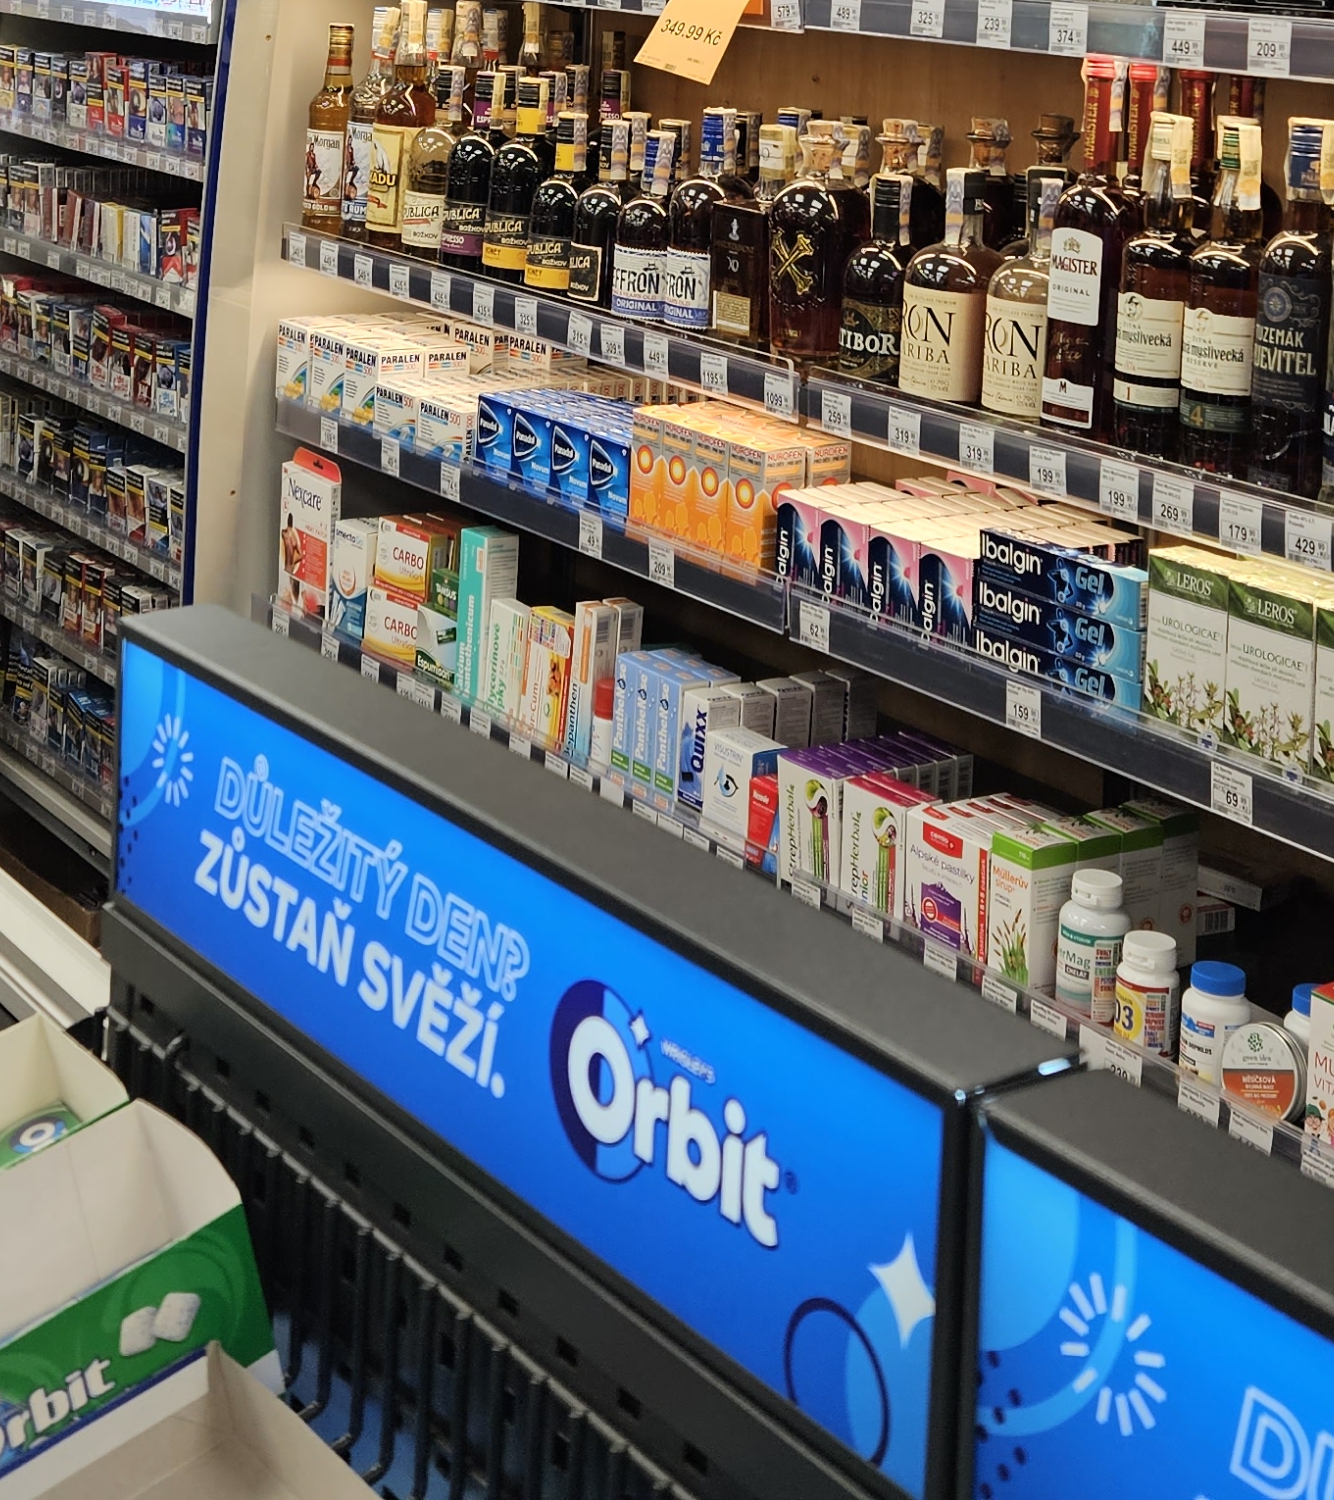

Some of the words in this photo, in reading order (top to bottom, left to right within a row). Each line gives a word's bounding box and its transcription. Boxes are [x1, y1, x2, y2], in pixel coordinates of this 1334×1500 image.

[777, 5, 792, 18] 579
[918, 11, 933, 25] 325
[660, 18, 704, 42] 349.99
[1256, 43, 1276, 58] 209
[311, 135, 341, 151] Morgan
[403, 205, 440, 221] PUBLICA
[1050, 253, 1098, 277] MAGISTER
[1052, 284, 1090, 297] ORIGINAL
[454, 327, 490, 348] PARALEN
[1256, 323, 1305, 348] UZEMÁK
[381, 353, 421, 366] PARALEN
[768, 391, 789, 407] 1099
[730, 443, 762, 461] NUROFEN
[768, 450, 804, 463] NUROFEN
[287, 476, 322, 511] Nexcare
[393, 547, 424, 570] CARBO
[982, 531, 1043, 577] Ibalgin
[654, 561, 667, 576] 209
[1075, 565, 1105, 596] Gel
[1177, 572, 1214, 599] LEROS
[978, 581, 1041, 626] Ibalgin
[1257, 598, 1298, 627] LEROS
[1075, 617, 1105, 647] Gel
[1161, 615, 1219, 643] UROLOGICAE
[1242, 643, 1305, 673] UROLOGICAE
[1012, 704, 1030, 721] 159
[690, 708, 708, 773] QUIXX
[213, 755, 407, 914] DŮLEŽITÝ
[407, 875, 530, 1002] DEN?
[941, 858, 976, 885] pastilky
[195, 830, 354, 988] ZŮSTAŇ
[358, 940, 506, 1099] SVĚŽÍ.
[566, 1014, 780, 1249] Orbit
